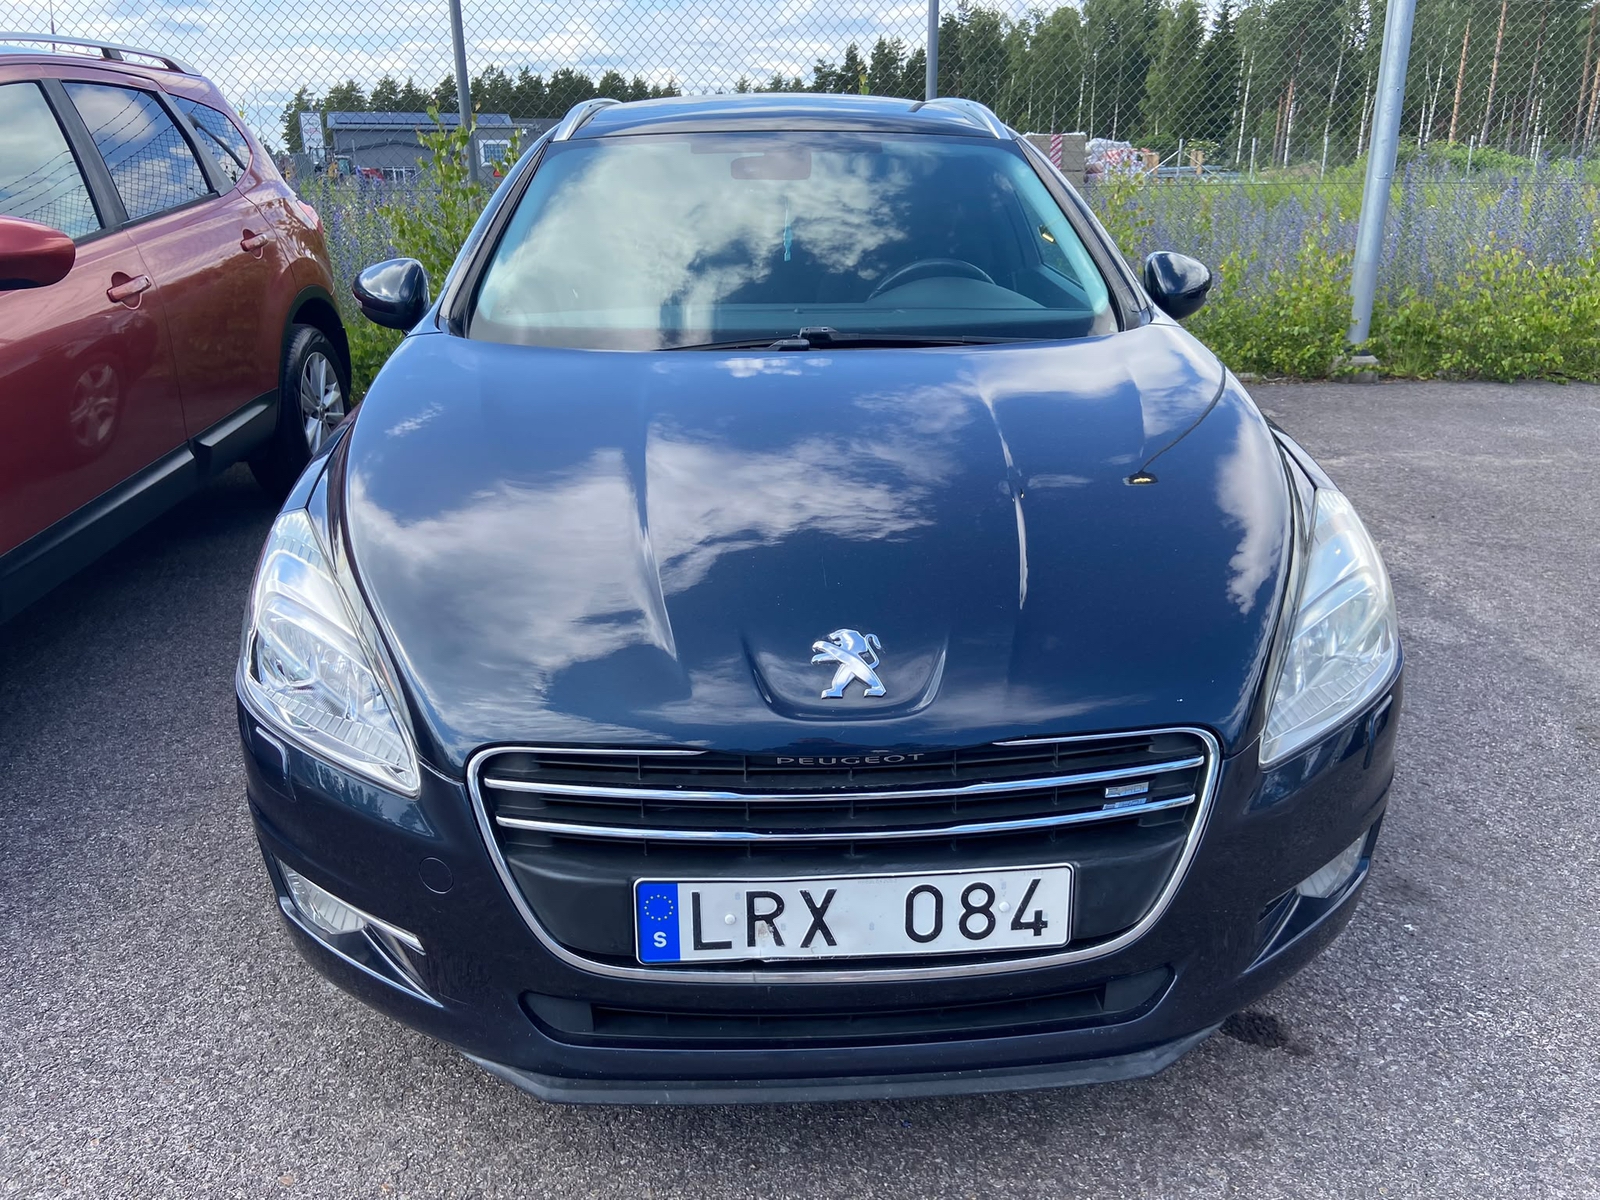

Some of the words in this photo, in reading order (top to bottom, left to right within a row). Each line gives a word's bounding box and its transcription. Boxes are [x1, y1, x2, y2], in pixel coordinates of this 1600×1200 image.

[776, 753, 925, 765] PEUGEOT
[692, 888, 837, 950] LRX
[905, 878, 1048, 943] 084
[653, 931, 667, 948] S
